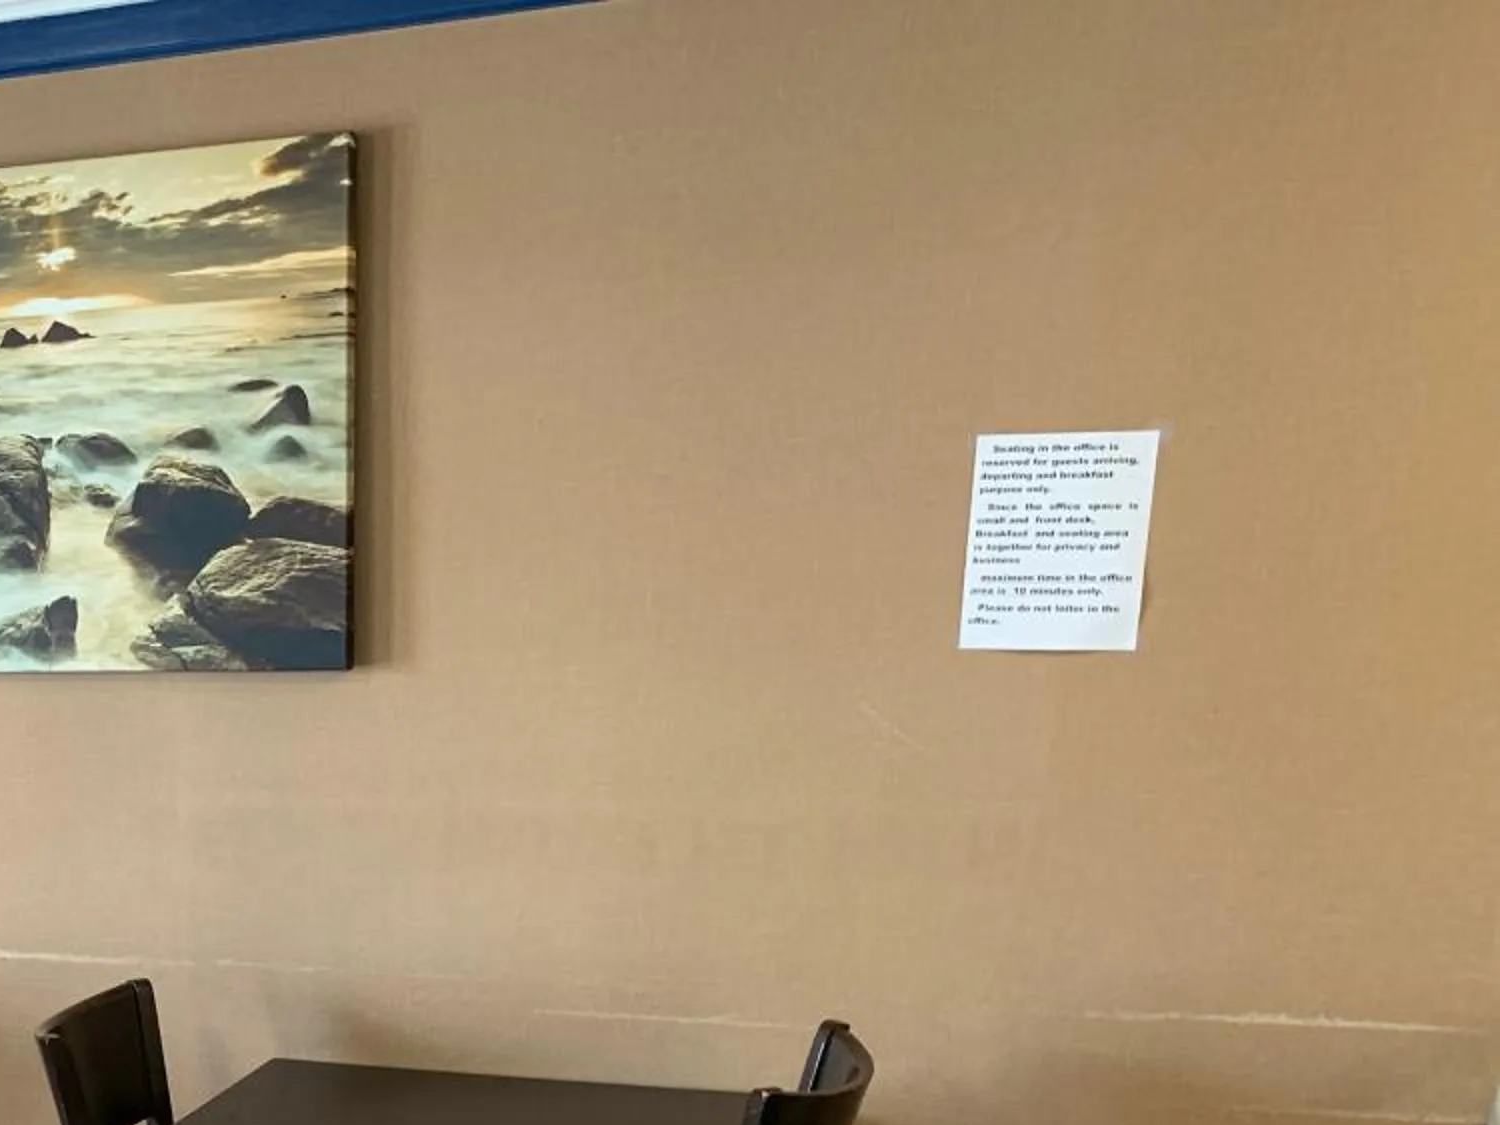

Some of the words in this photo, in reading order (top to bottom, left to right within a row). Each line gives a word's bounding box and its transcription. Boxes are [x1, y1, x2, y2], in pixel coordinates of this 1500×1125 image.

[993, 445, 1034, 454] Seating
[1073, 444, 1105, 452] office
[1109, 443, 1118, 451] is
[980, 472, 1032, 481] departing
[986, 543, 1033, 552] together
[1036, 543, 1051, 551] for
[1054, 543, 1096, 552] privacy
[1014, 587, 1026, 595] 10
[978, 604, 1014, 612] Please
